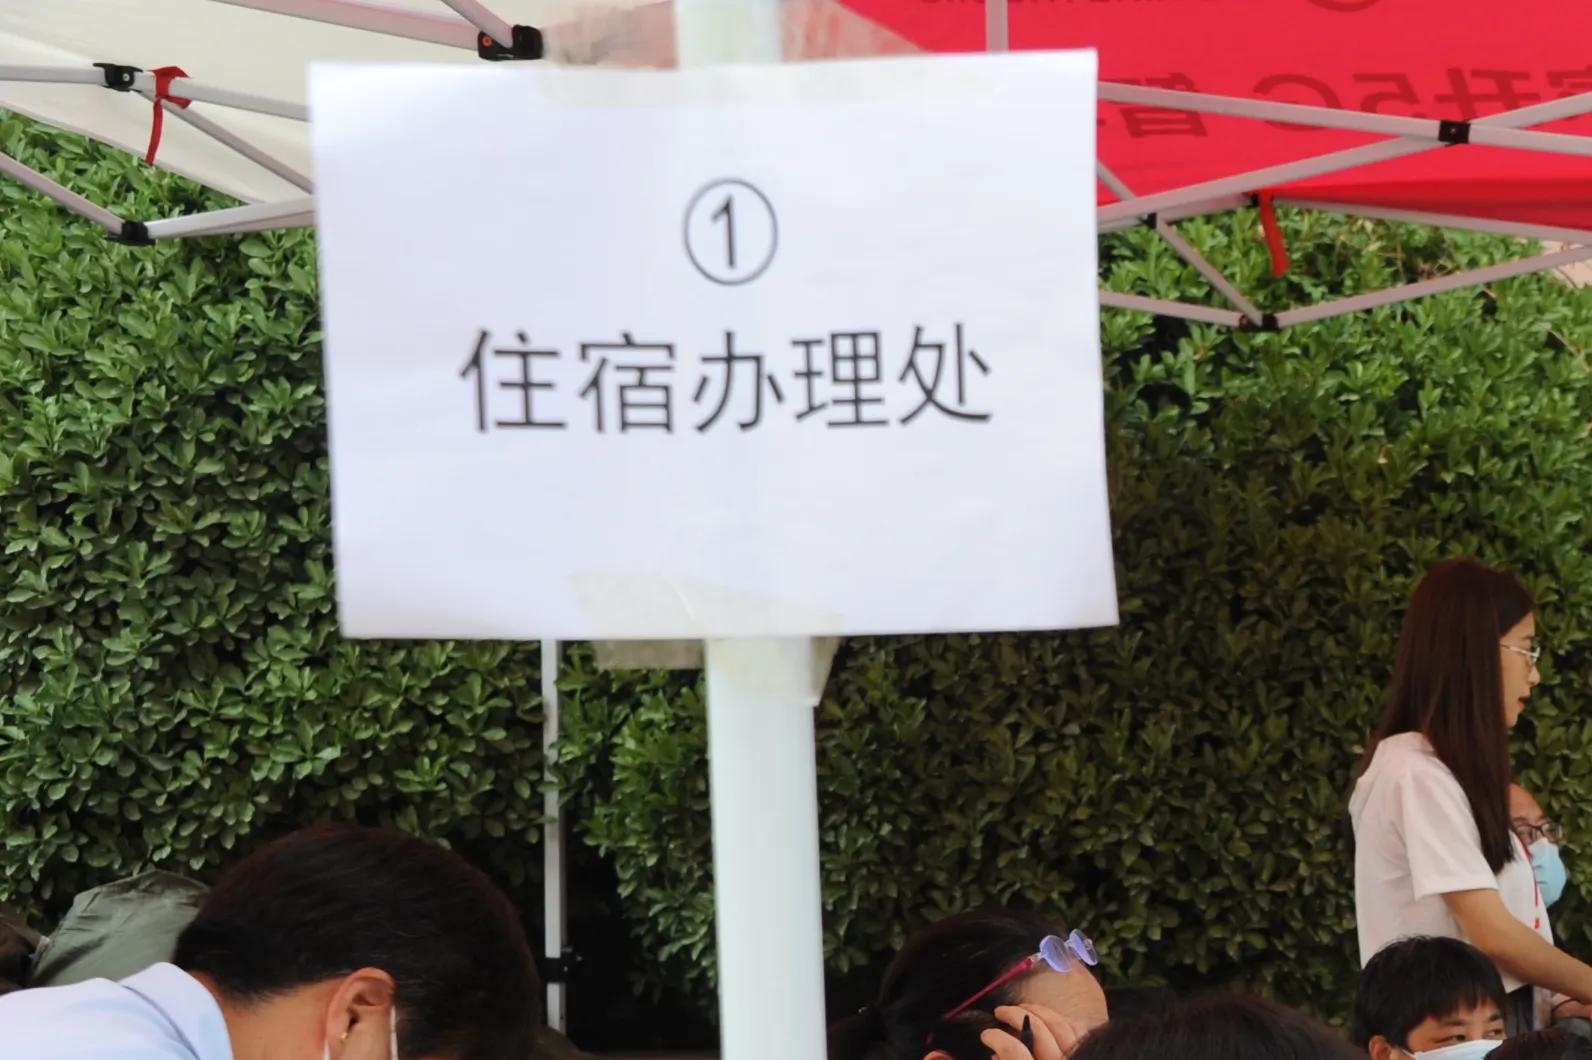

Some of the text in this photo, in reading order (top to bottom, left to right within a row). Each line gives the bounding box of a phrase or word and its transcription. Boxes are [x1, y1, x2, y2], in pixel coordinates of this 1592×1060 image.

[458, 322, 993, 433] 住宿办理处
